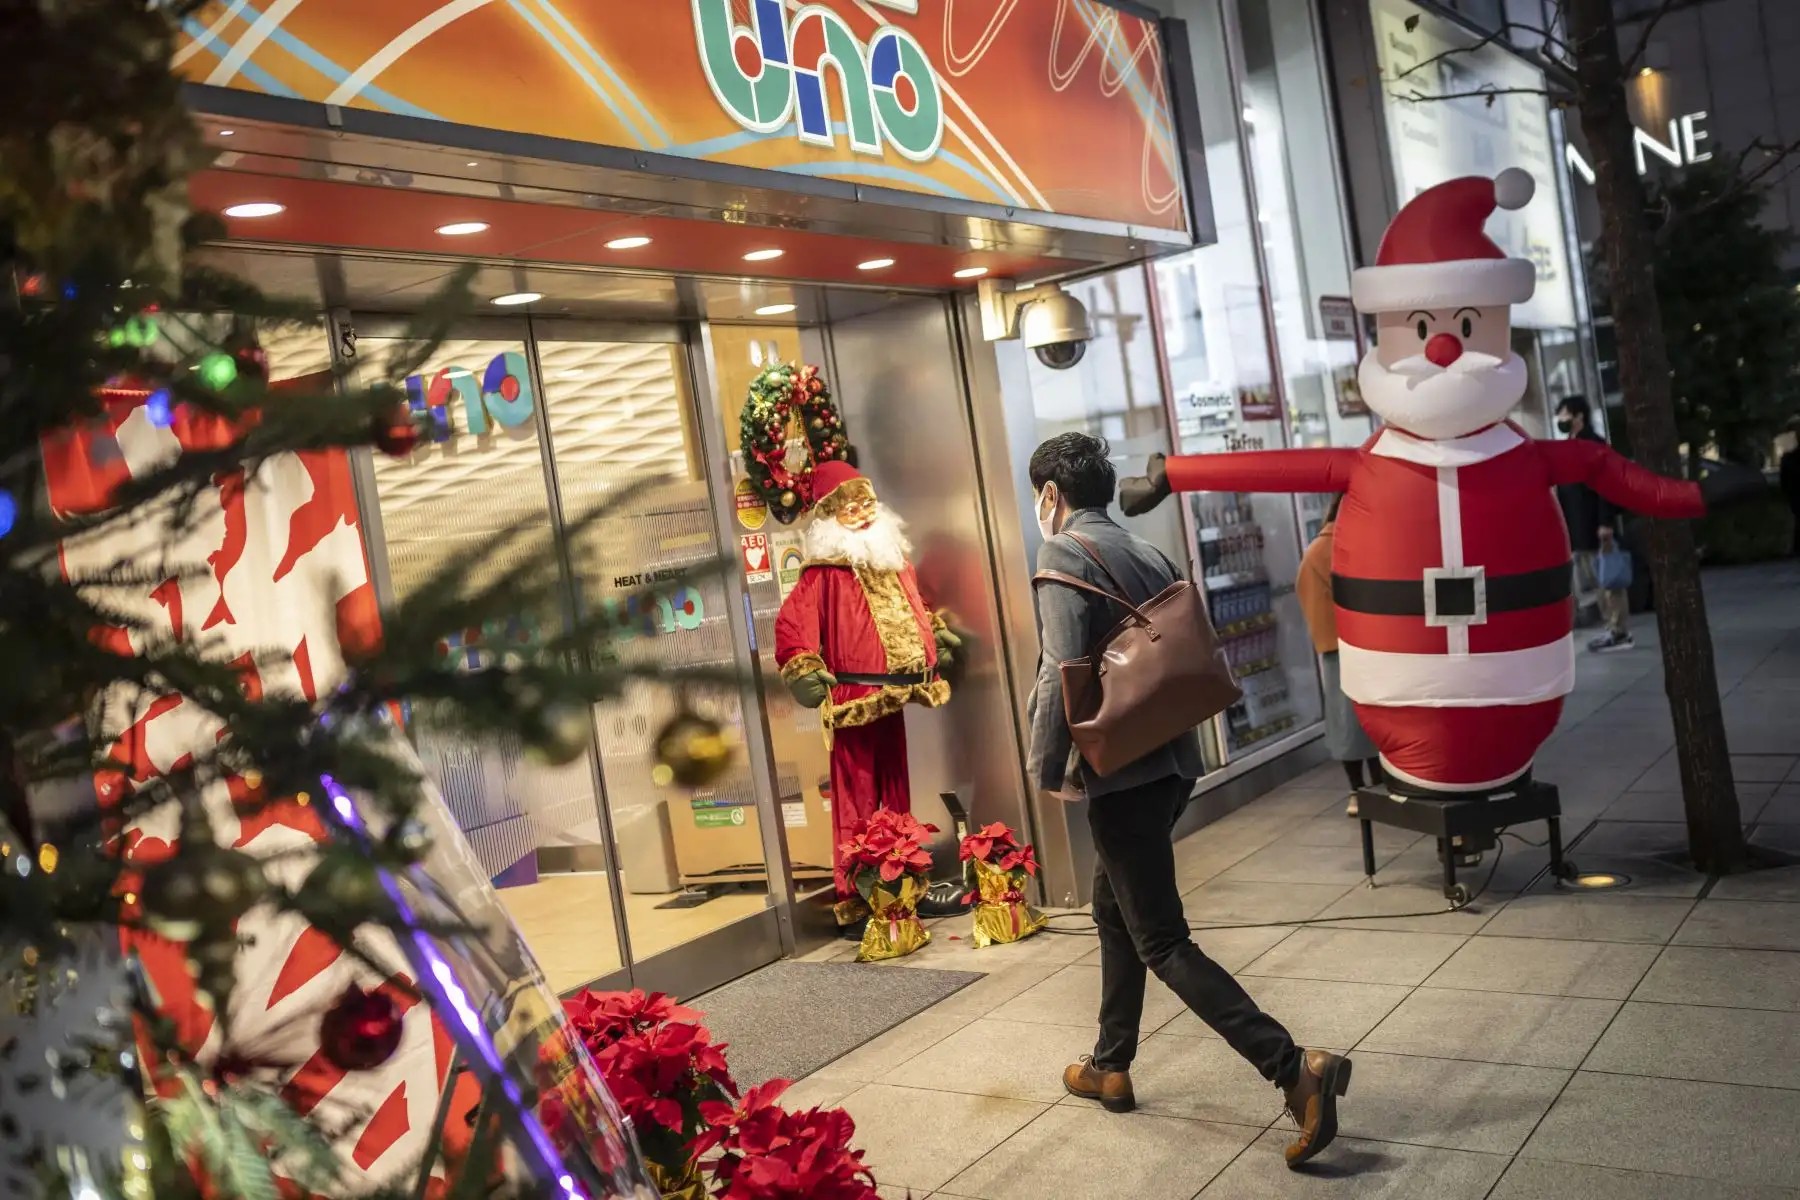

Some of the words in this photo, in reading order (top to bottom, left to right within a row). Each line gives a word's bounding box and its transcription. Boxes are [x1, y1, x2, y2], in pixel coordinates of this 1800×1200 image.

[692, 0, 945, 162] uno
[1190, 392, 1232, 407] Cosmetic
[1223, 434, 1264, 450] TaxFree
[740, 535, 765, 547] AED
[614, 574, 642, 588] HEAT
[645, 574, 652, 584] &
